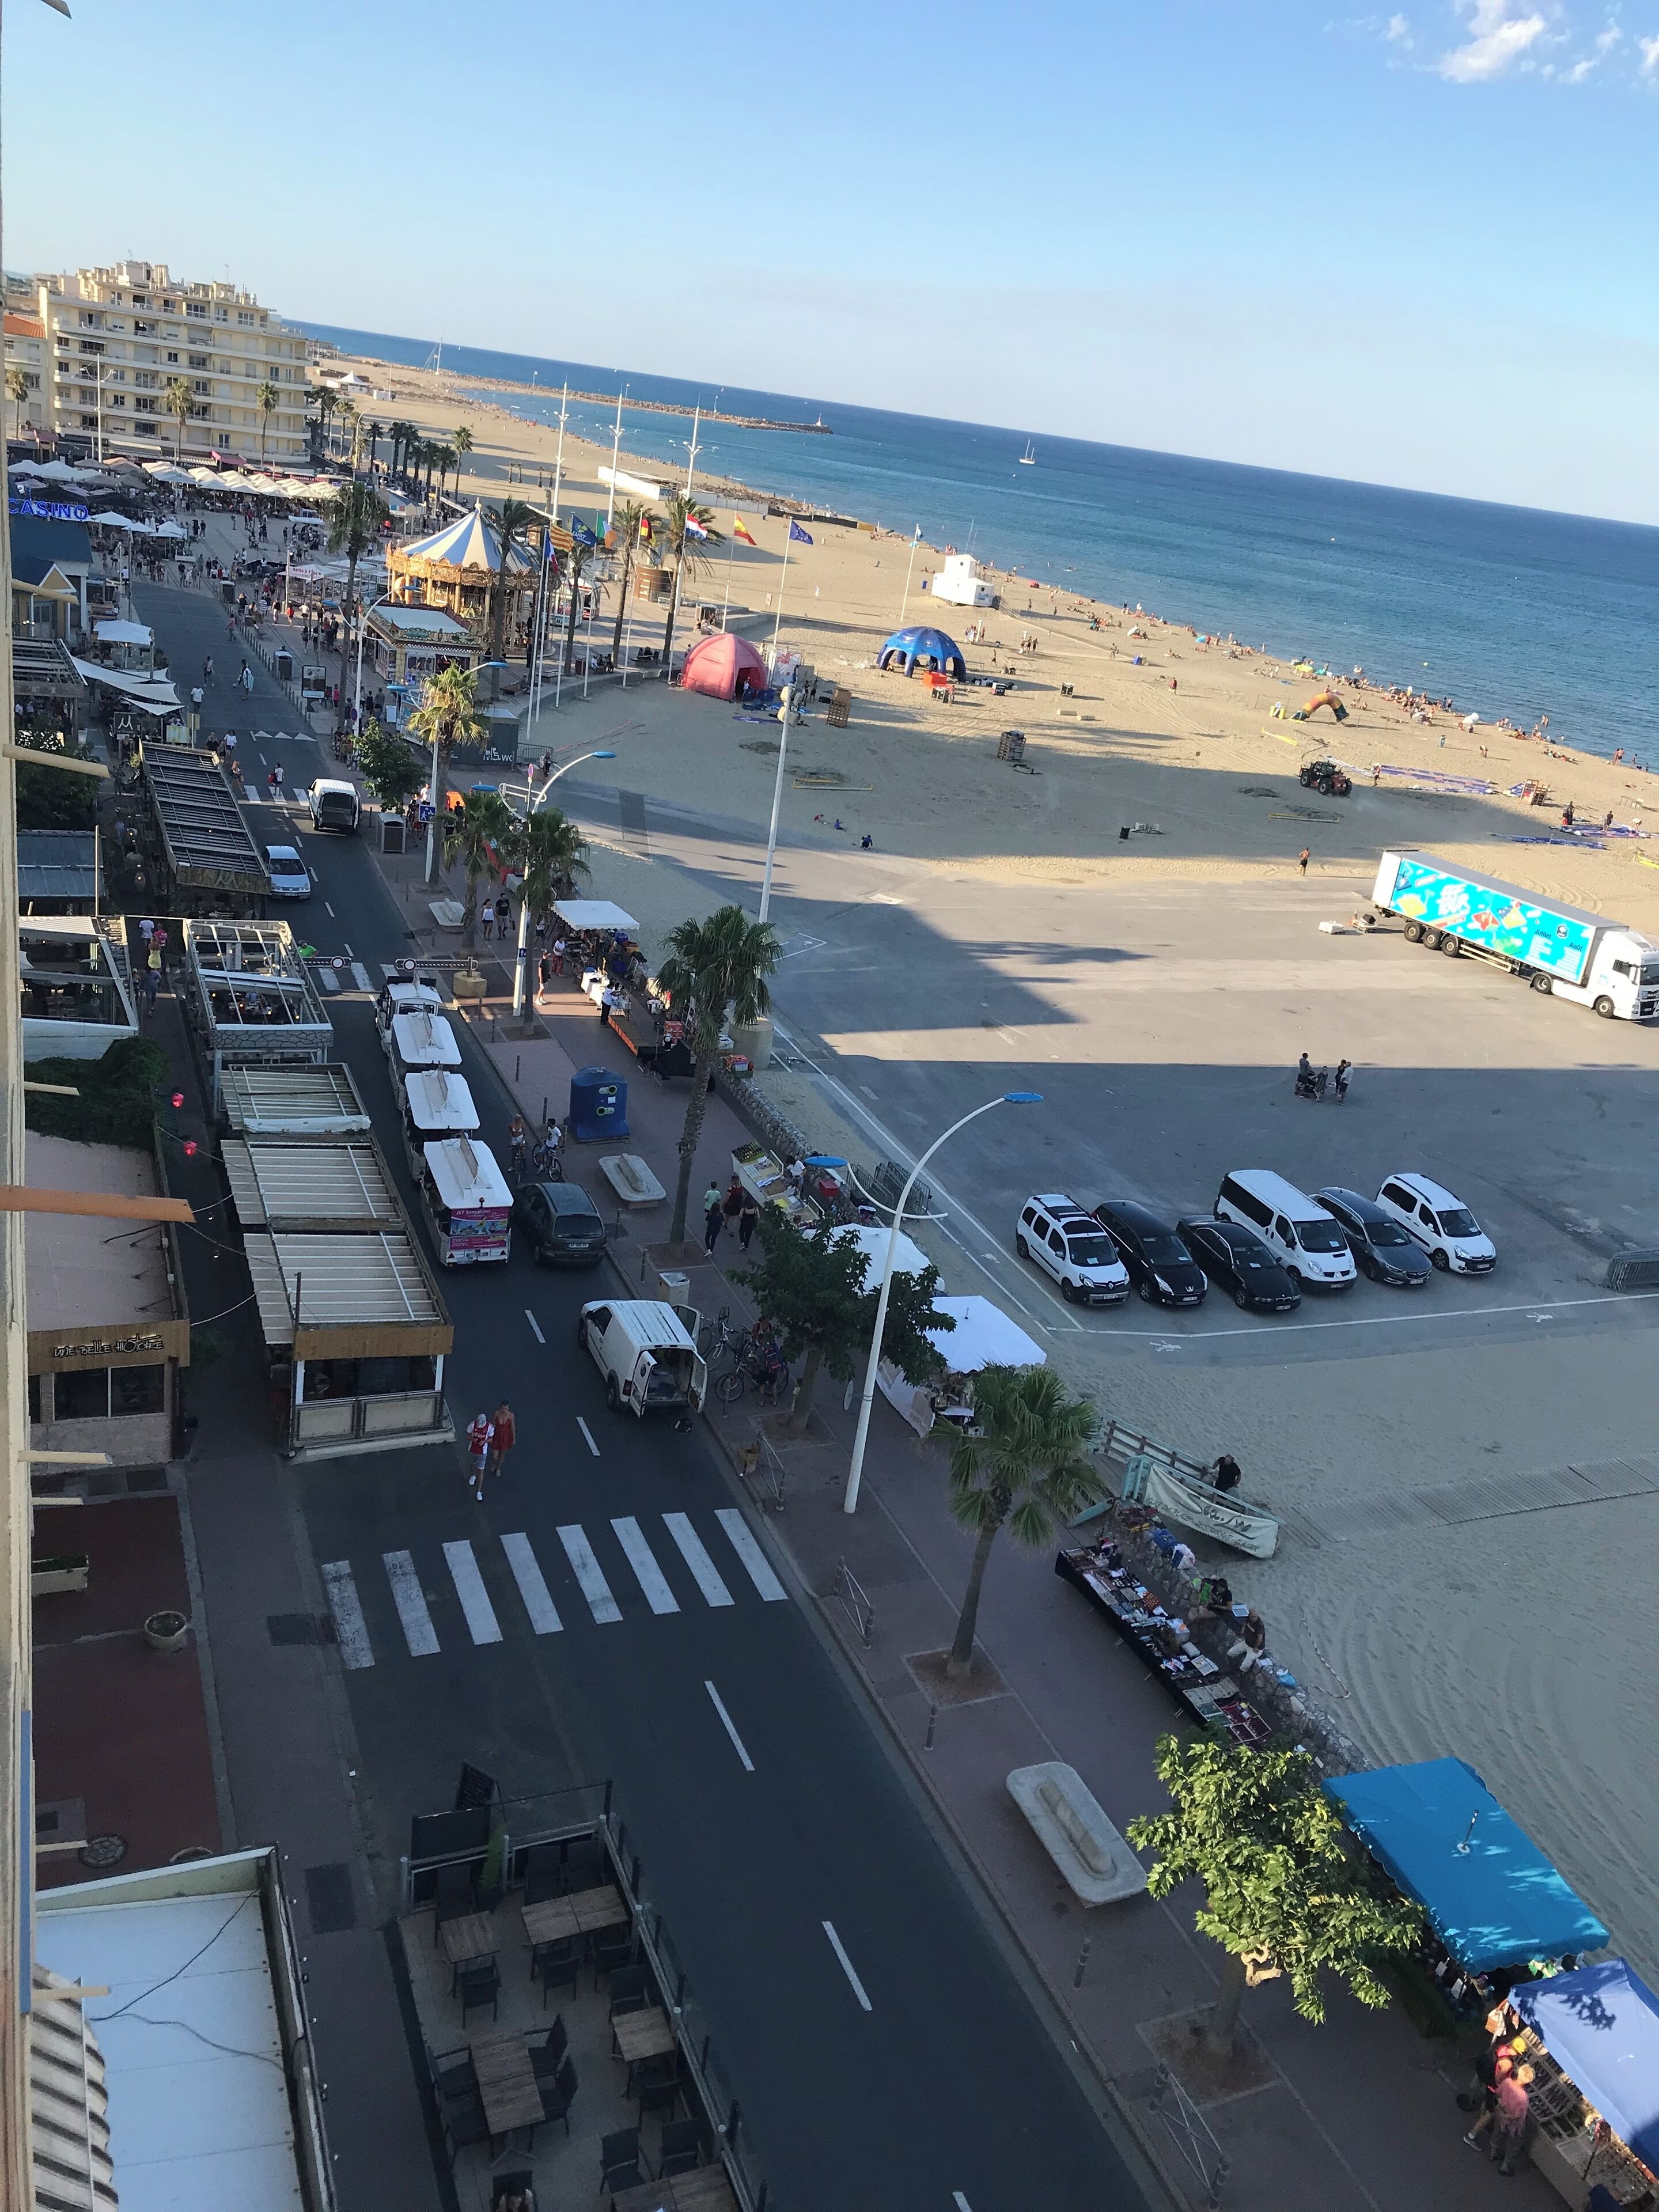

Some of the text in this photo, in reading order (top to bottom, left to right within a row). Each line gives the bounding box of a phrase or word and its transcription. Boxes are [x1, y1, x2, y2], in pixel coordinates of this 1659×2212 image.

[9, 498, 89, 520] CASINO
[1535, 929, 1552, 940] Juillet
[1569, 942, 1583, 952] Août
[54, 1346, 76, 1359] UNE
